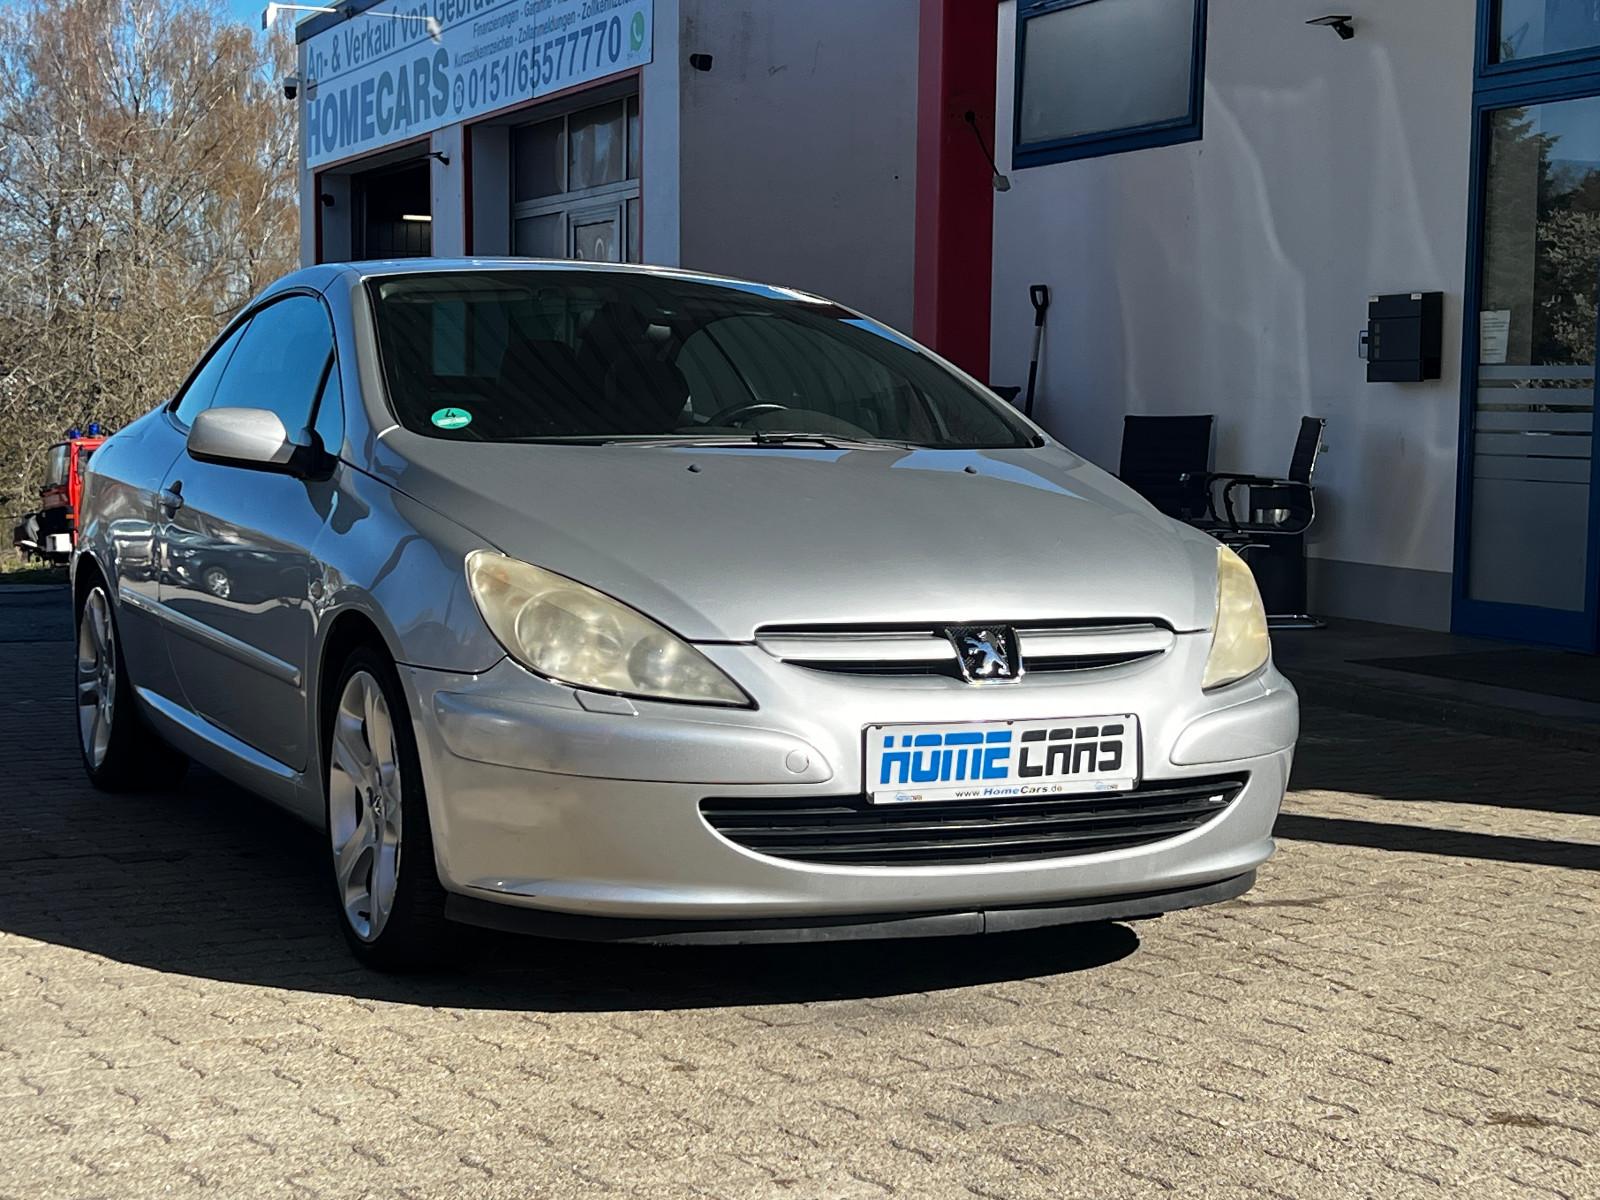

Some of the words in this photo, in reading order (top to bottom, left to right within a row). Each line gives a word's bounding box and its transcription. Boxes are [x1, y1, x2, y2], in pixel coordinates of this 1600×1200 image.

[307, 44, 328, 81] An-
[331, 35, 341, 73] &
[344, 6, 398, 67] Verkauf
[400, 10, 428, 43] von
[468, 15, 622, 109] 0151/65577770
[306, 48, 450, 158] HOMECARS
[880, 730, 1012, 784] HOME
